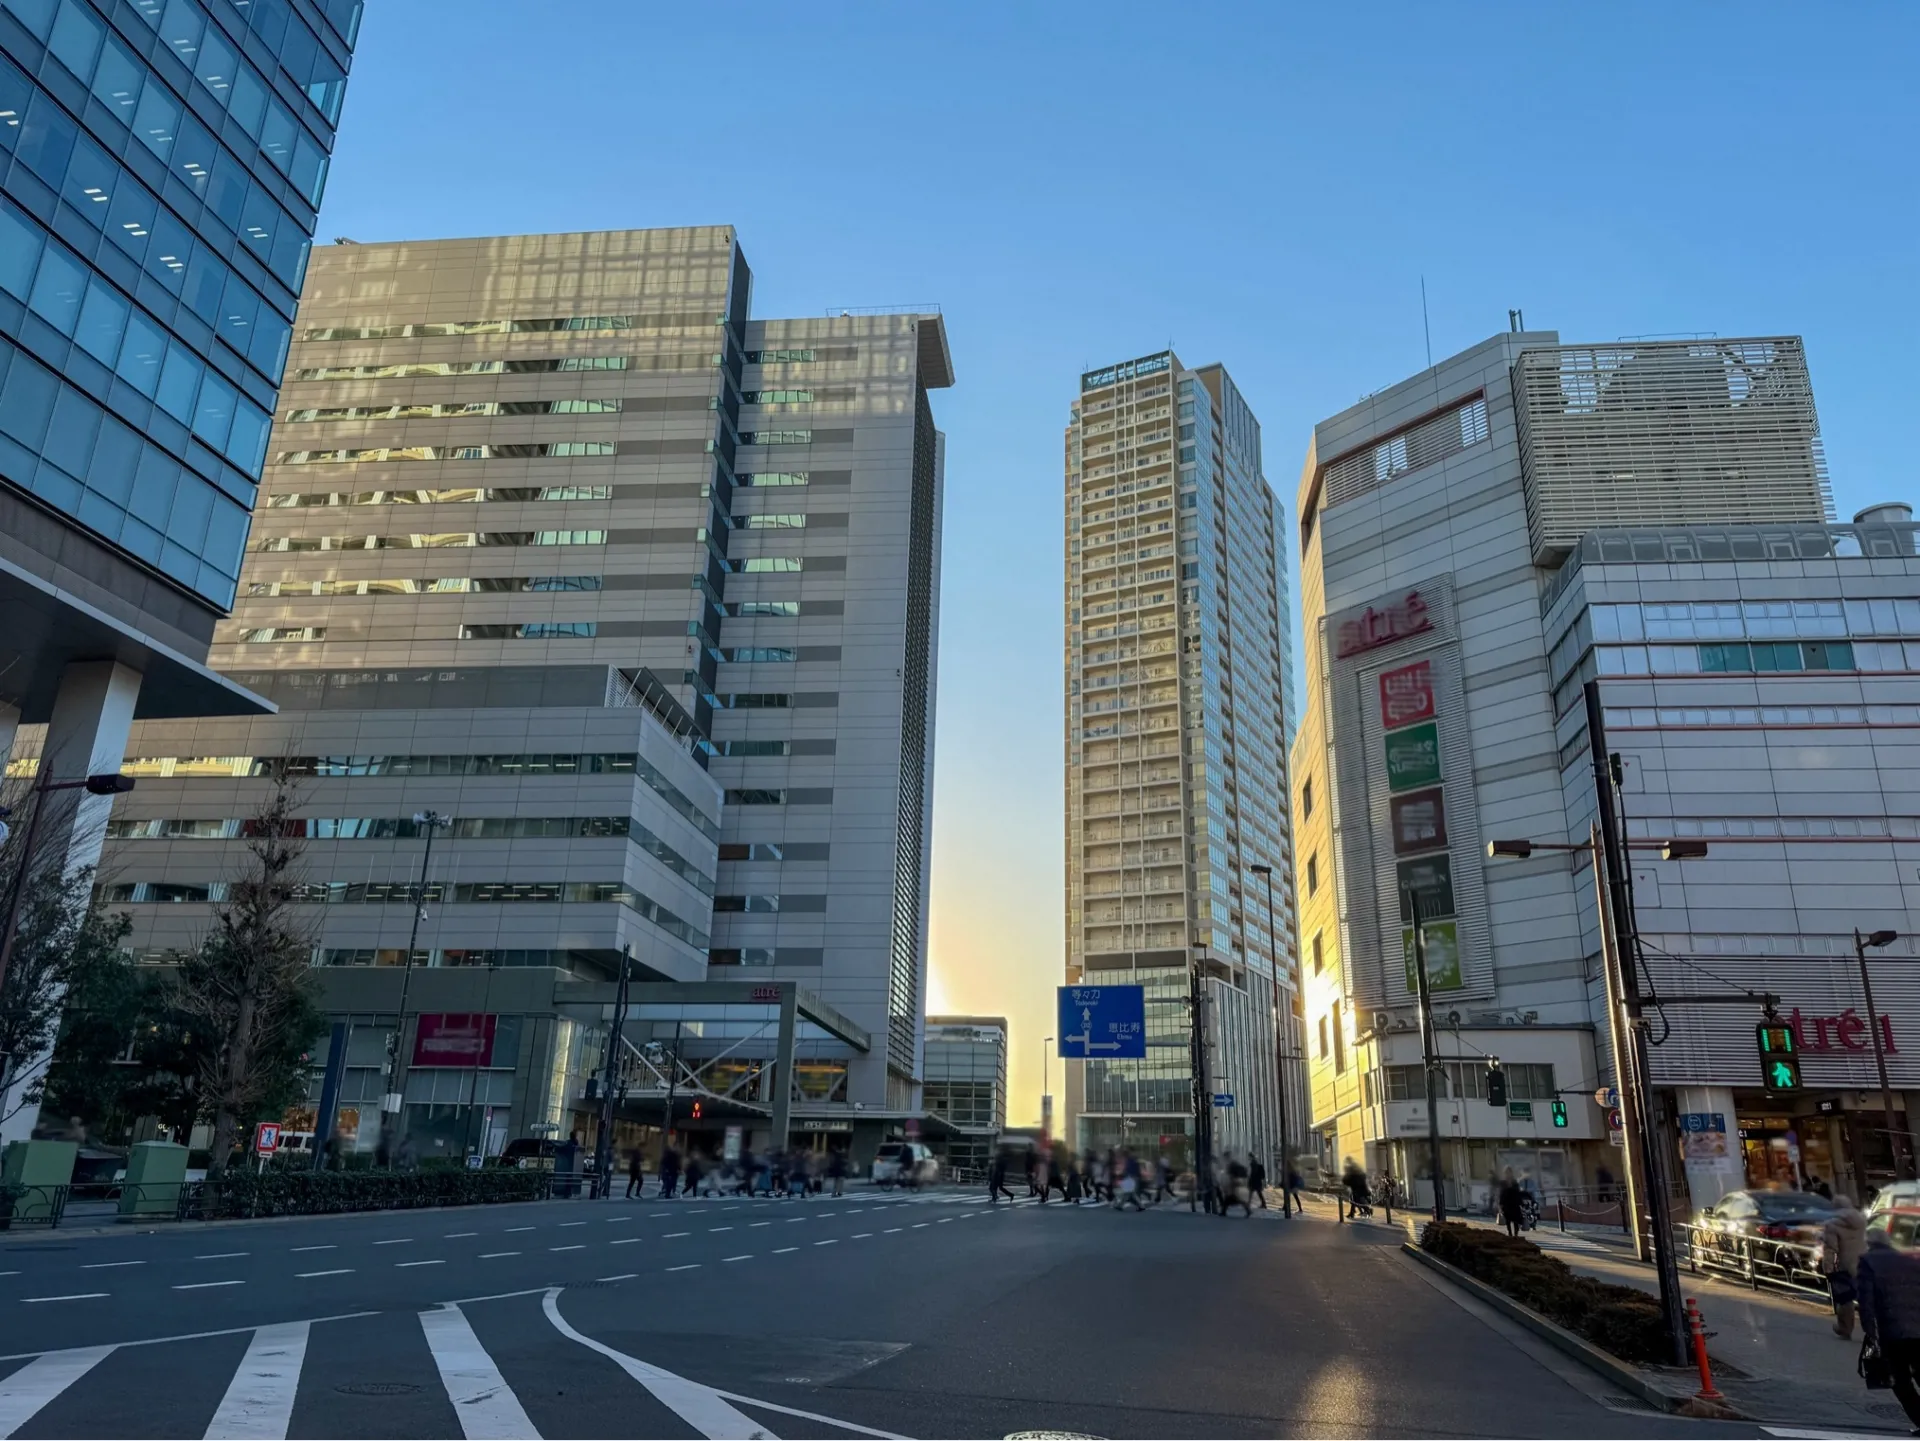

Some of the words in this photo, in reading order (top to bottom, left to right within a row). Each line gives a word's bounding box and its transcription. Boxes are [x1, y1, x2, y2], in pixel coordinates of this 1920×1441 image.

[752, 984, 781, 997] atré
[1072, 989, 1100, 999] 等々力
[1108, 1022, 1140, 1033] 恵比寿
[1776, 1007, 1868, 1050] tré
